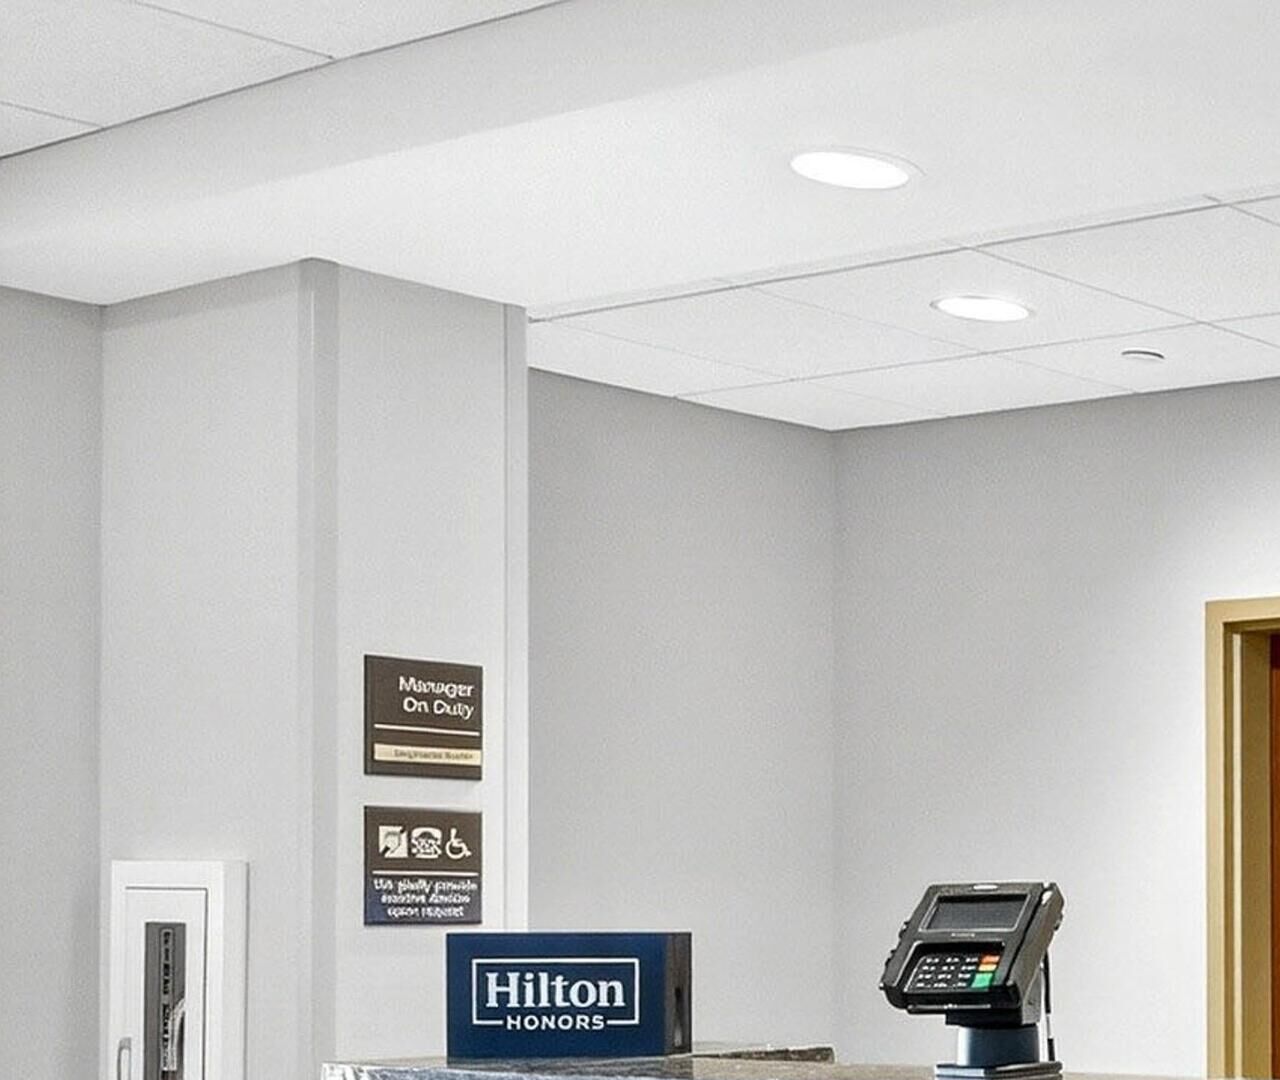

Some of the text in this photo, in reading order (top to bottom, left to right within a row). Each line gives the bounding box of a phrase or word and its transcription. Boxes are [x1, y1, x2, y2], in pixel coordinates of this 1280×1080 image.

[399, 676, 475, 698] Manager
[403, 697, 475, 720] On Duty
[484, 972, 626, 1008] Hilton
[506, 1015, 605, 1030] HONORS
